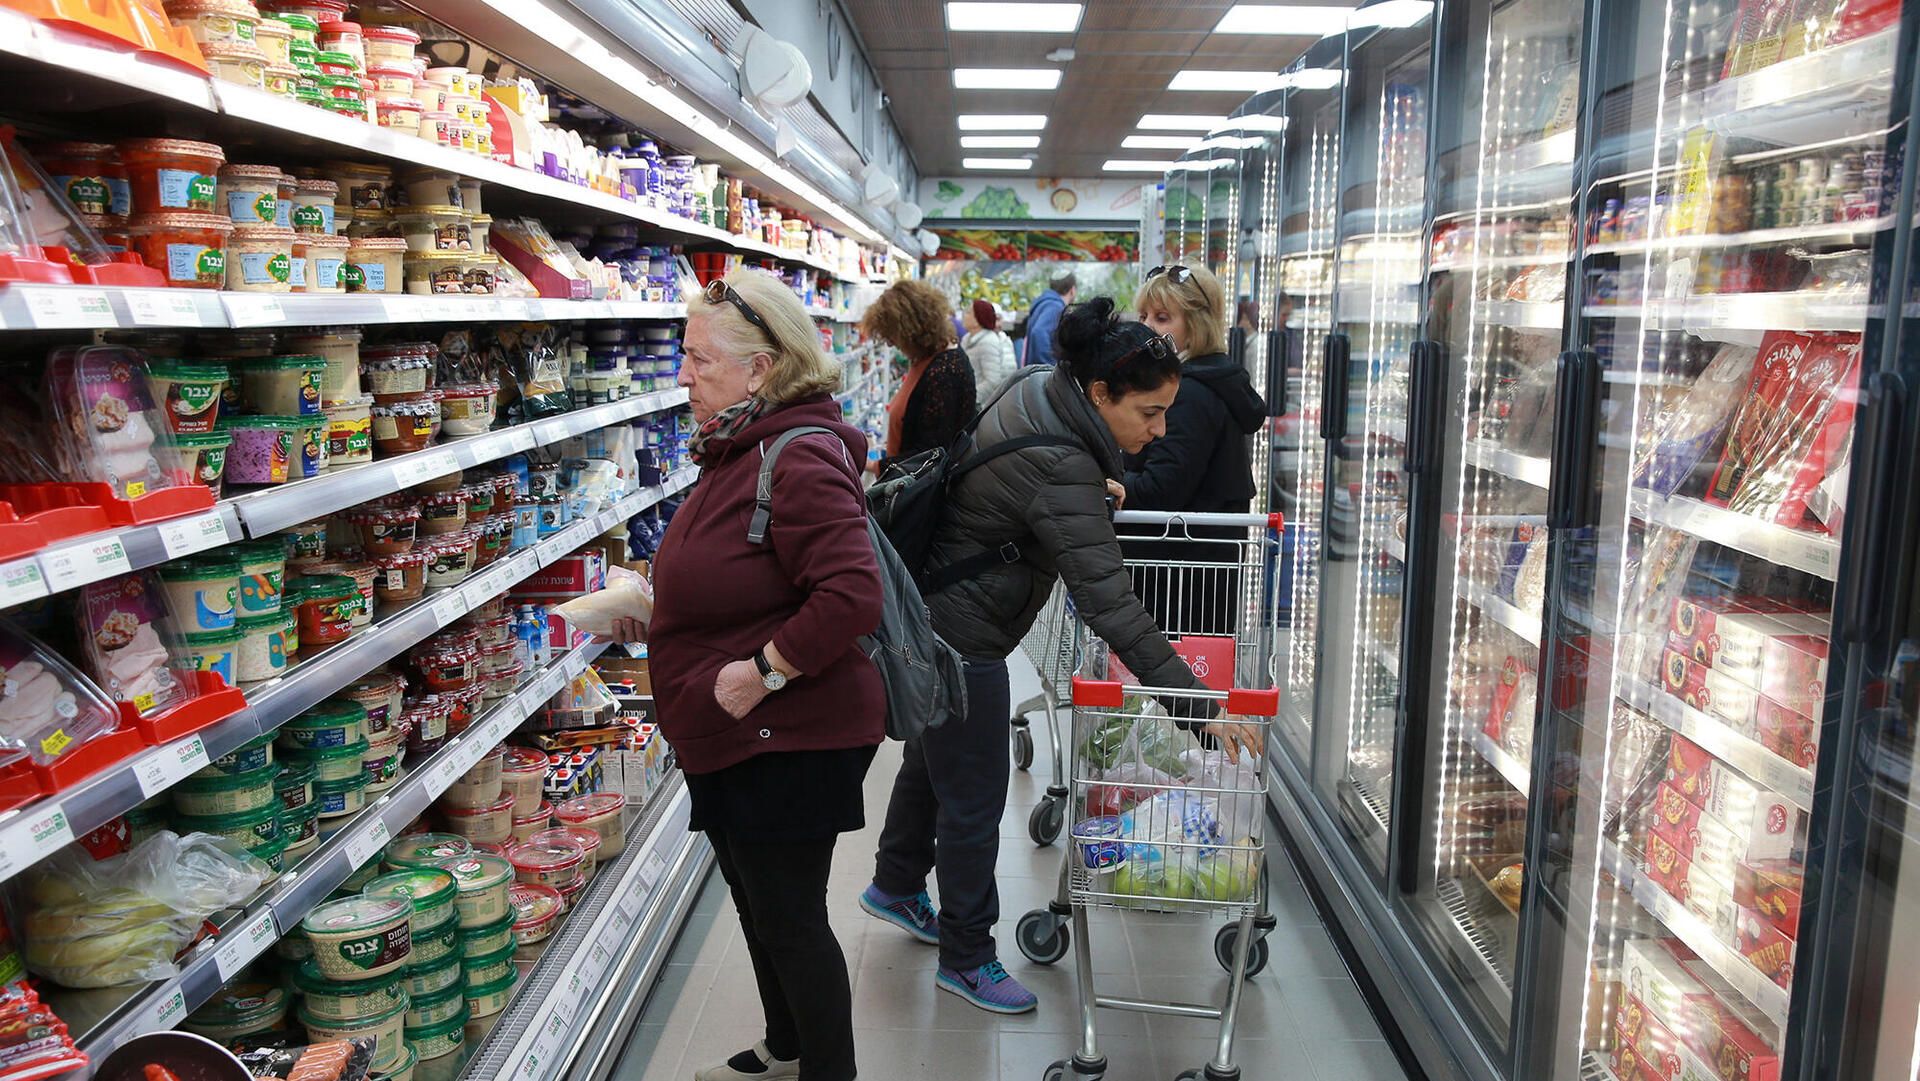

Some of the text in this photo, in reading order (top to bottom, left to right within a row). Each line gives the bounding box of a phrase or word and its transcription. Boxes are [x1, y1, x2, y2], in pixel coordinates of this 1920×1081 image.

[73, 185, 103, 197] צבר
[195, 183, 214, 195] צבר
[260, 200, 276, 209] צבר
[298, 210, 320, 221] צבר
[203, 256, 223, 267] צבר
[273, 259, 289, 268] צבר
[346, 270, 360, 281] צב
[184, 387, 211, 397] צבר
[350, 439, 367, 448] צבר
[299, 541, 318, 549] צבר
[551, 576, 574, 584] שמנת
[623, 710, 647, 718] שמנת
[256, 821, 273, 834] צבר
[269, 854, 282, 867] צבר
[388, 928, 409, 941] חומוס
[343, 938, 379, 956] צבר
[389, 937, 409, 949] מסעדה
